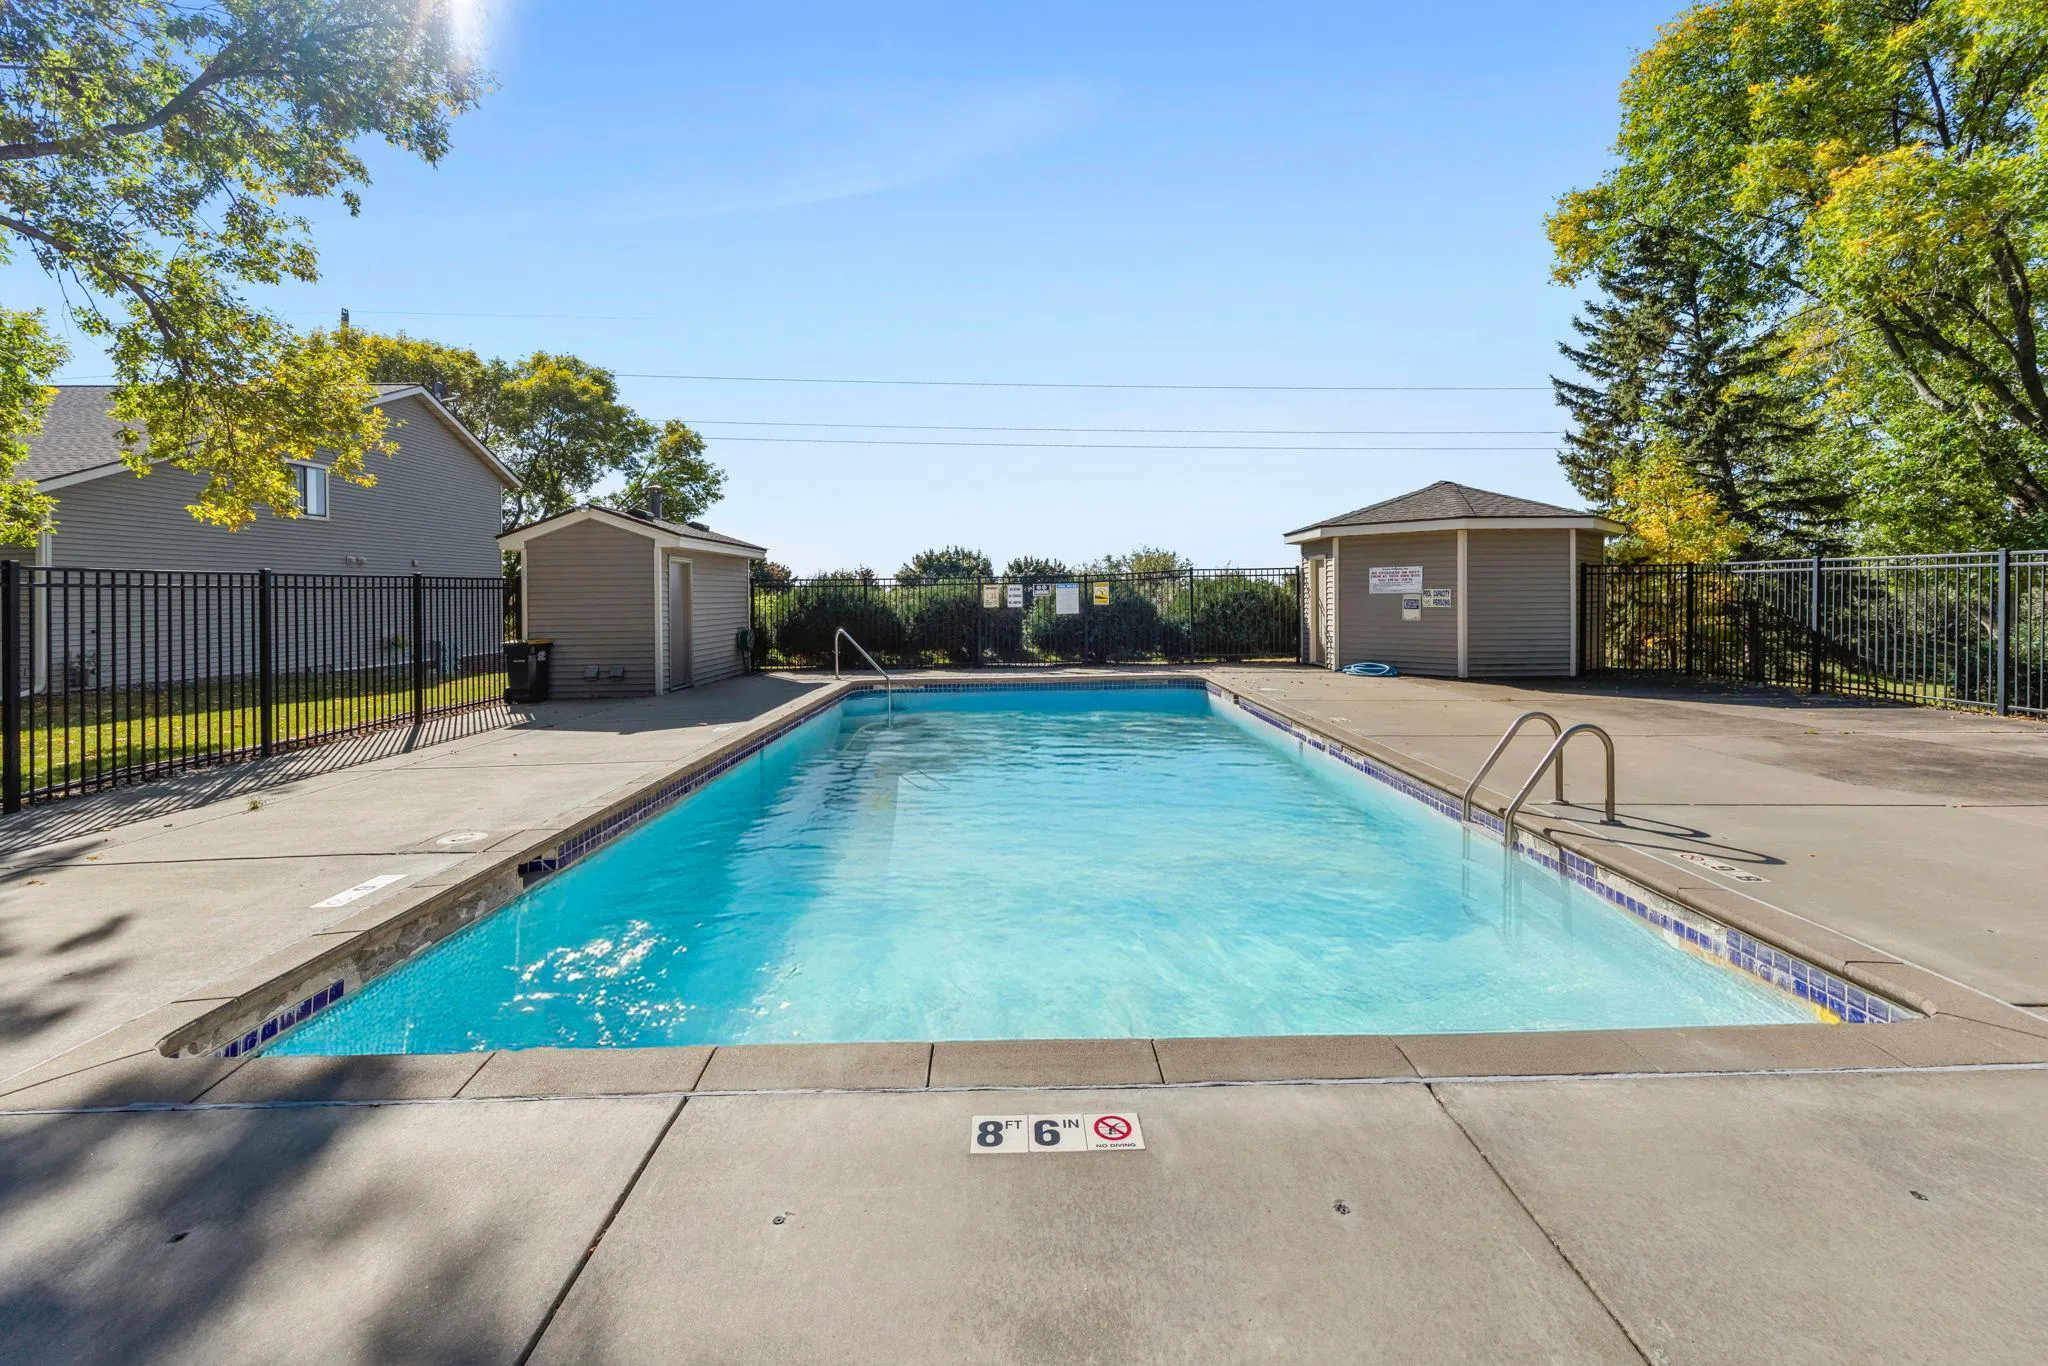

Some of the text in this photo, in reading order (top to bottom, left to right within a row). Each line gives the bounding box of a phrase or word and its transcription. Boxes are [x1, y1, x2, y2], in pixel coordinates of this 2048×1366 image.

[977, 1119, 1079, 1147] 8 FT 6 IN
